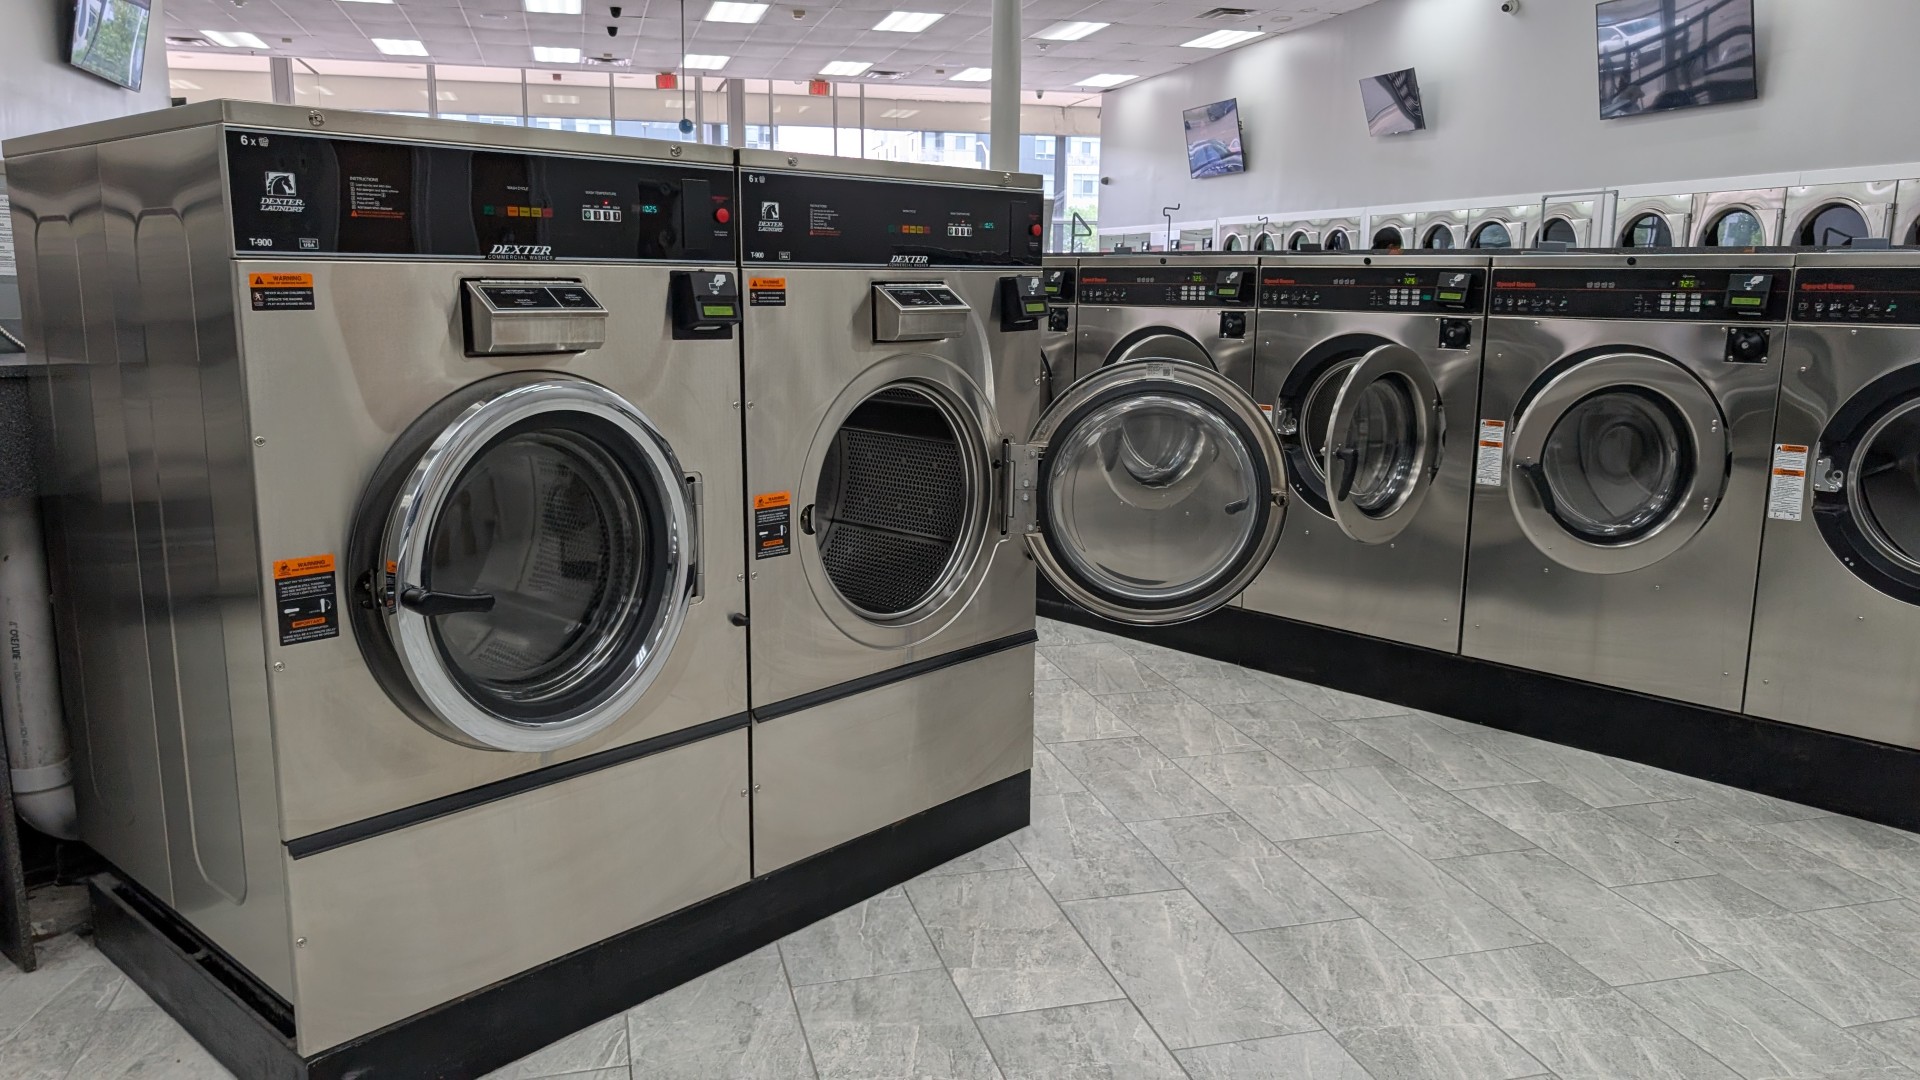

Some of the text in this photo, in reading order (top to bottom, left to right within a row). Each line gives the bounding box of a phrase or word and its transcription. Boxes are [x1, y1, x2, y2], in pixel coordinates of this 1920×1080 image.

[241, 135, 248, 145] 6
[749, 174, 754, 183] 6
[260, 198, 304, 206] DEXTER
[249, 238, 272, 246] T-900
[490, 245, 552, 255] DEXTER
[890, 255, 928, 263] DEXTER
[1801, 283, 1827, 291] Speed
[294, 618, 323, 627] IMPORTANT
